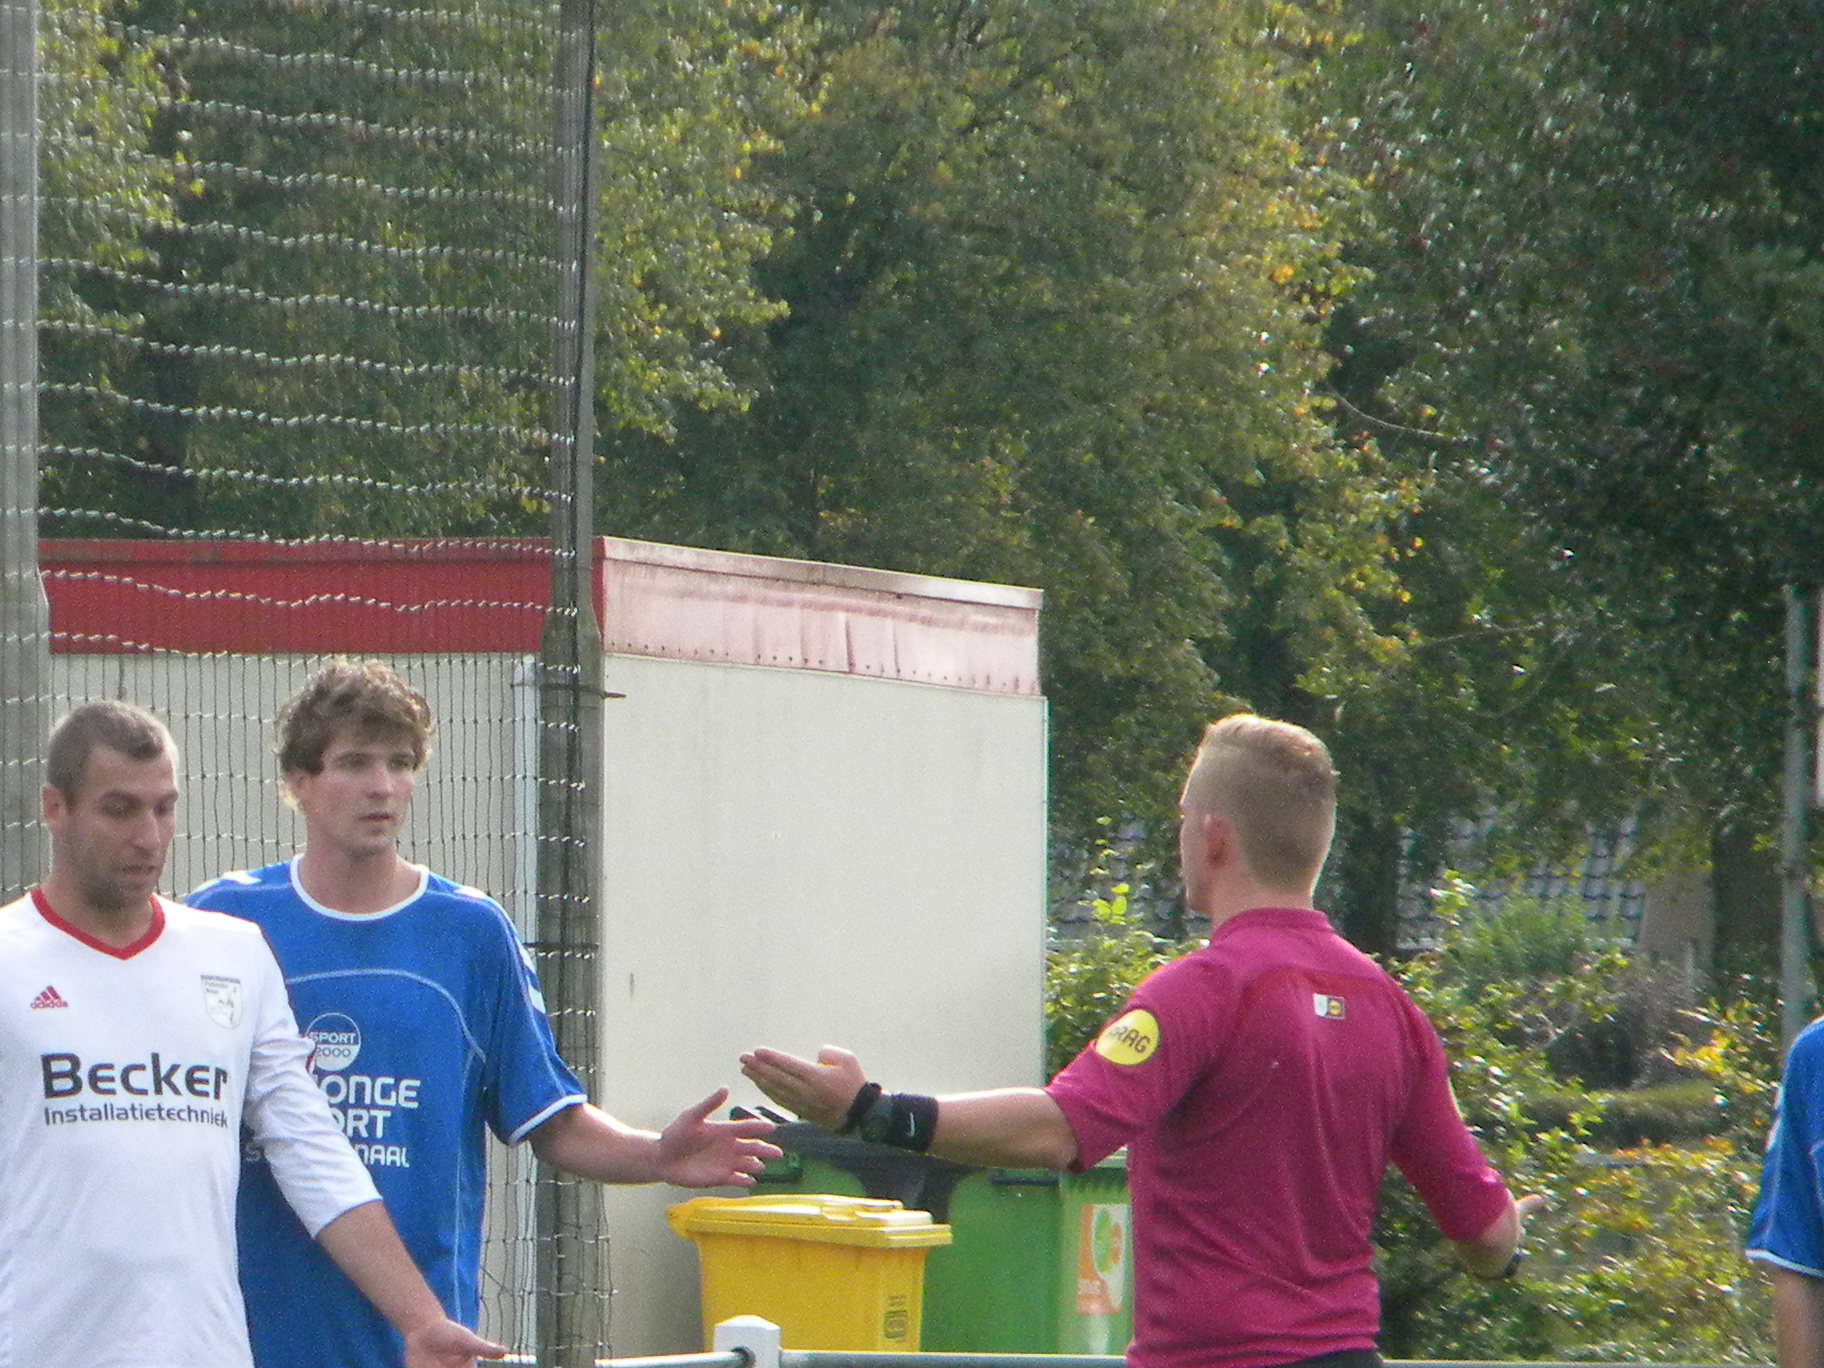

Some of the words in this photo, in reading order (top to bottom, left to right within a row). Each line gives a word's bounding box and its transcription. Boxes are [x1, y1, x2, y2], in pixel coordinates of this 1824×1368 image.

[40, 1052, 228, 1101] Becker
[311, 1073, 422, 1109] ONGE
[43, 1102, 229, 1129] Installatietechniek
